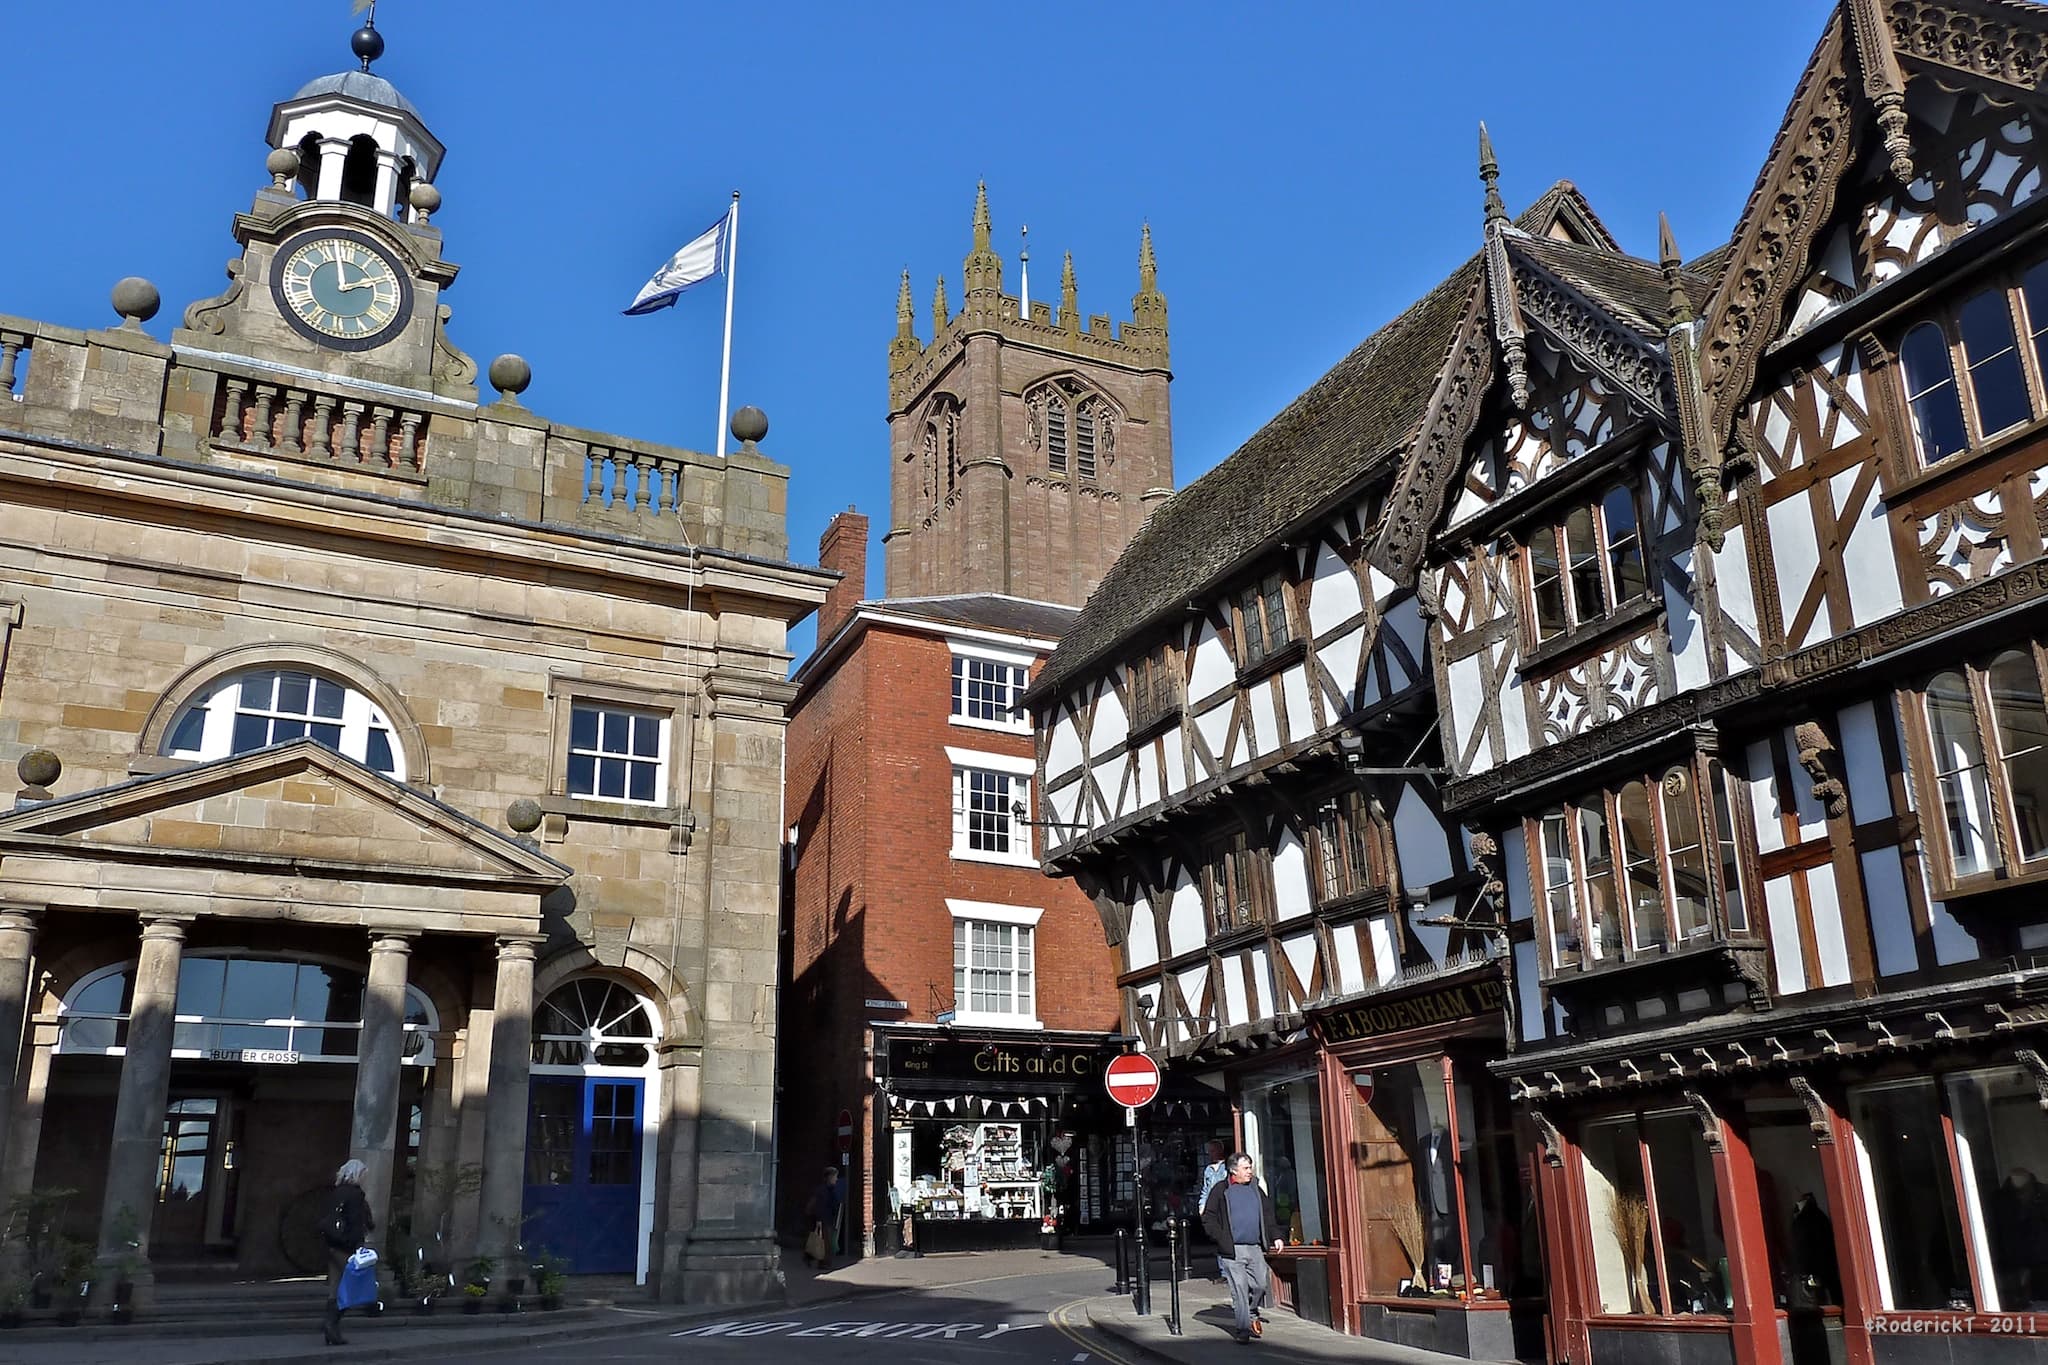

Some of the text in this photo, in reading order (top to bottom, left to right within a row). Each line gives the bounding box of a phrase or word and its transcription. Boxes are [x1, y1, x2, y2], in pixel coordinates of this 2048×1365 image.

[1358, 988, 1473, 1035] BODENHAM
[213, 1050, 297, 1063] BUTTER CROSS
[904, 1061, 920, 1070] King
[974, 1052, 1020, 1072] Gifts
[1026, 1054, 1066, 1074] and
[669, 1321, 1044, 1340] NO ENTRY
